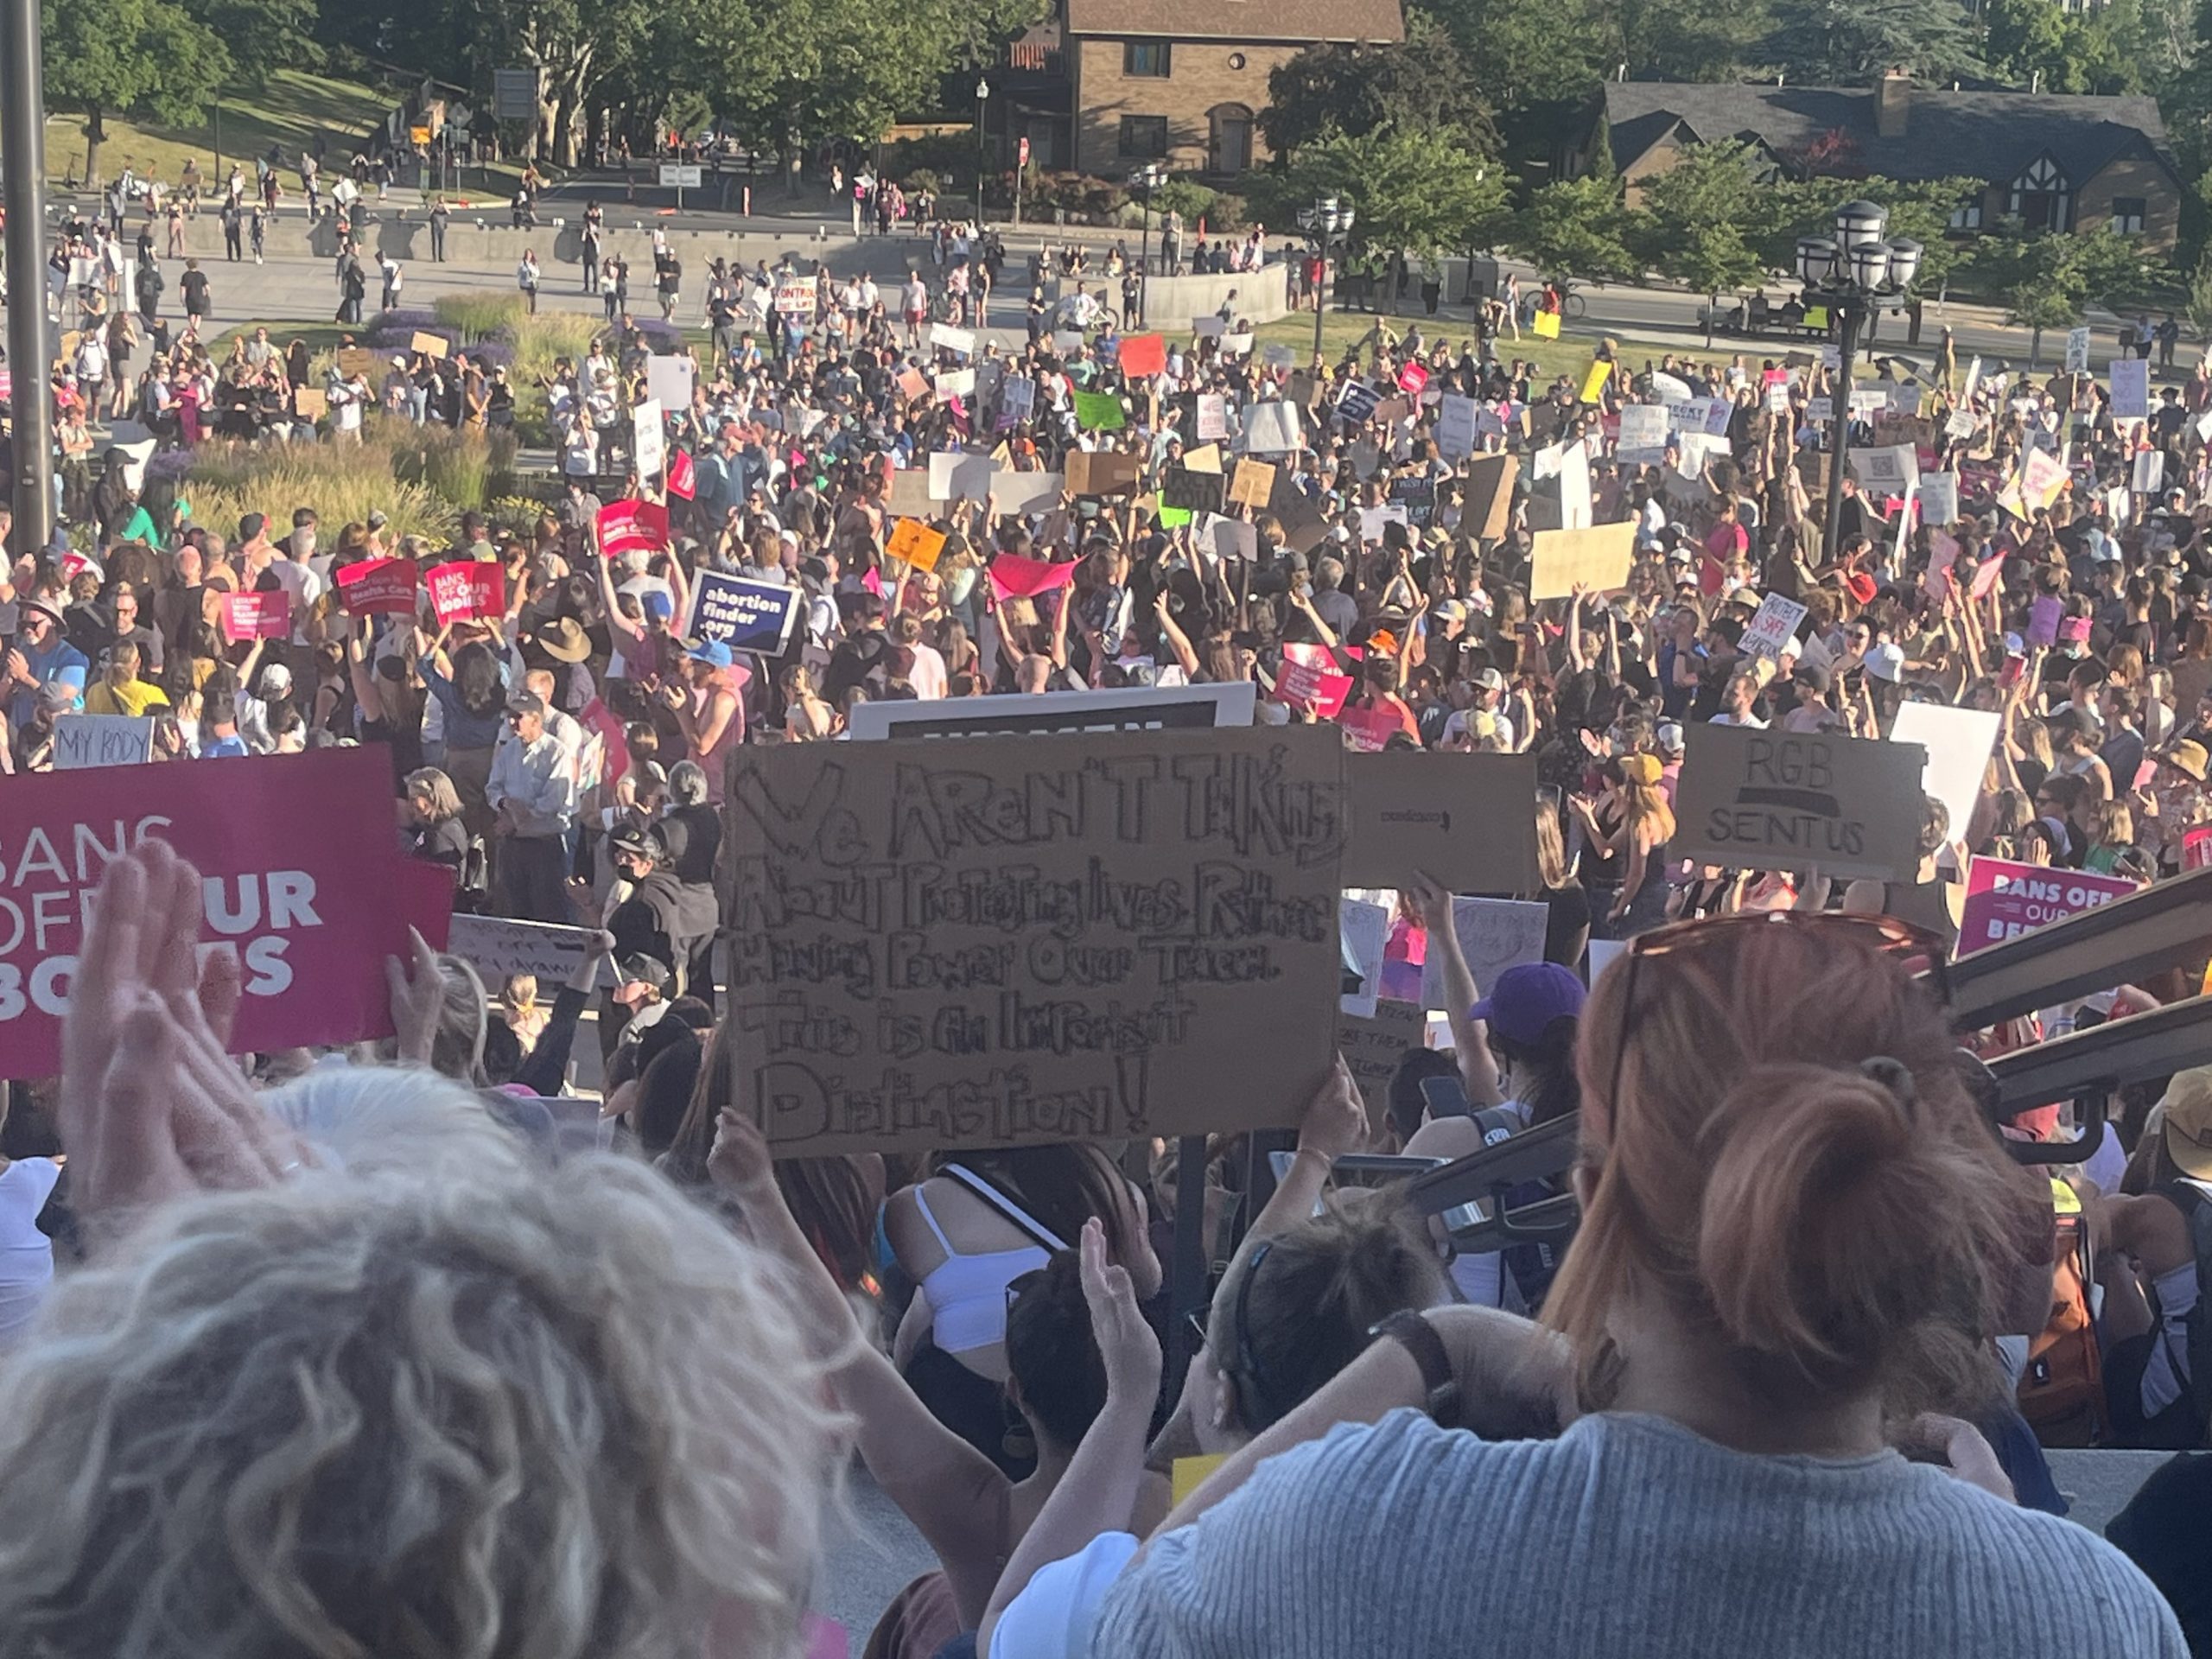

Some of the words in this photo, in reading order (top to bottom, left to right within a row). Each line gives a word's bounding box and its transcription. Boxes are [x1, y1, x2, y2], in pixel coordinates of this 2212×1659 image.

[702, 601, 757, 625] finder
[705, 588, 782, 614] abortion
[699, 620, 736, 638] .org
[58, 728, 92, 764] MY
[101, 728, 148, 762] BODY
[1746, 738, 1833, 788] RGB
[734, 760, 869, 866] We
[1706, 809, 1819, 848] SENT
[1824, 821, 1866, 855] US
[1993, 874, 2062, 903] BANS
[2067, 887, 2113, 908] OFF
[2025, 905, 2069, 923] OUR
